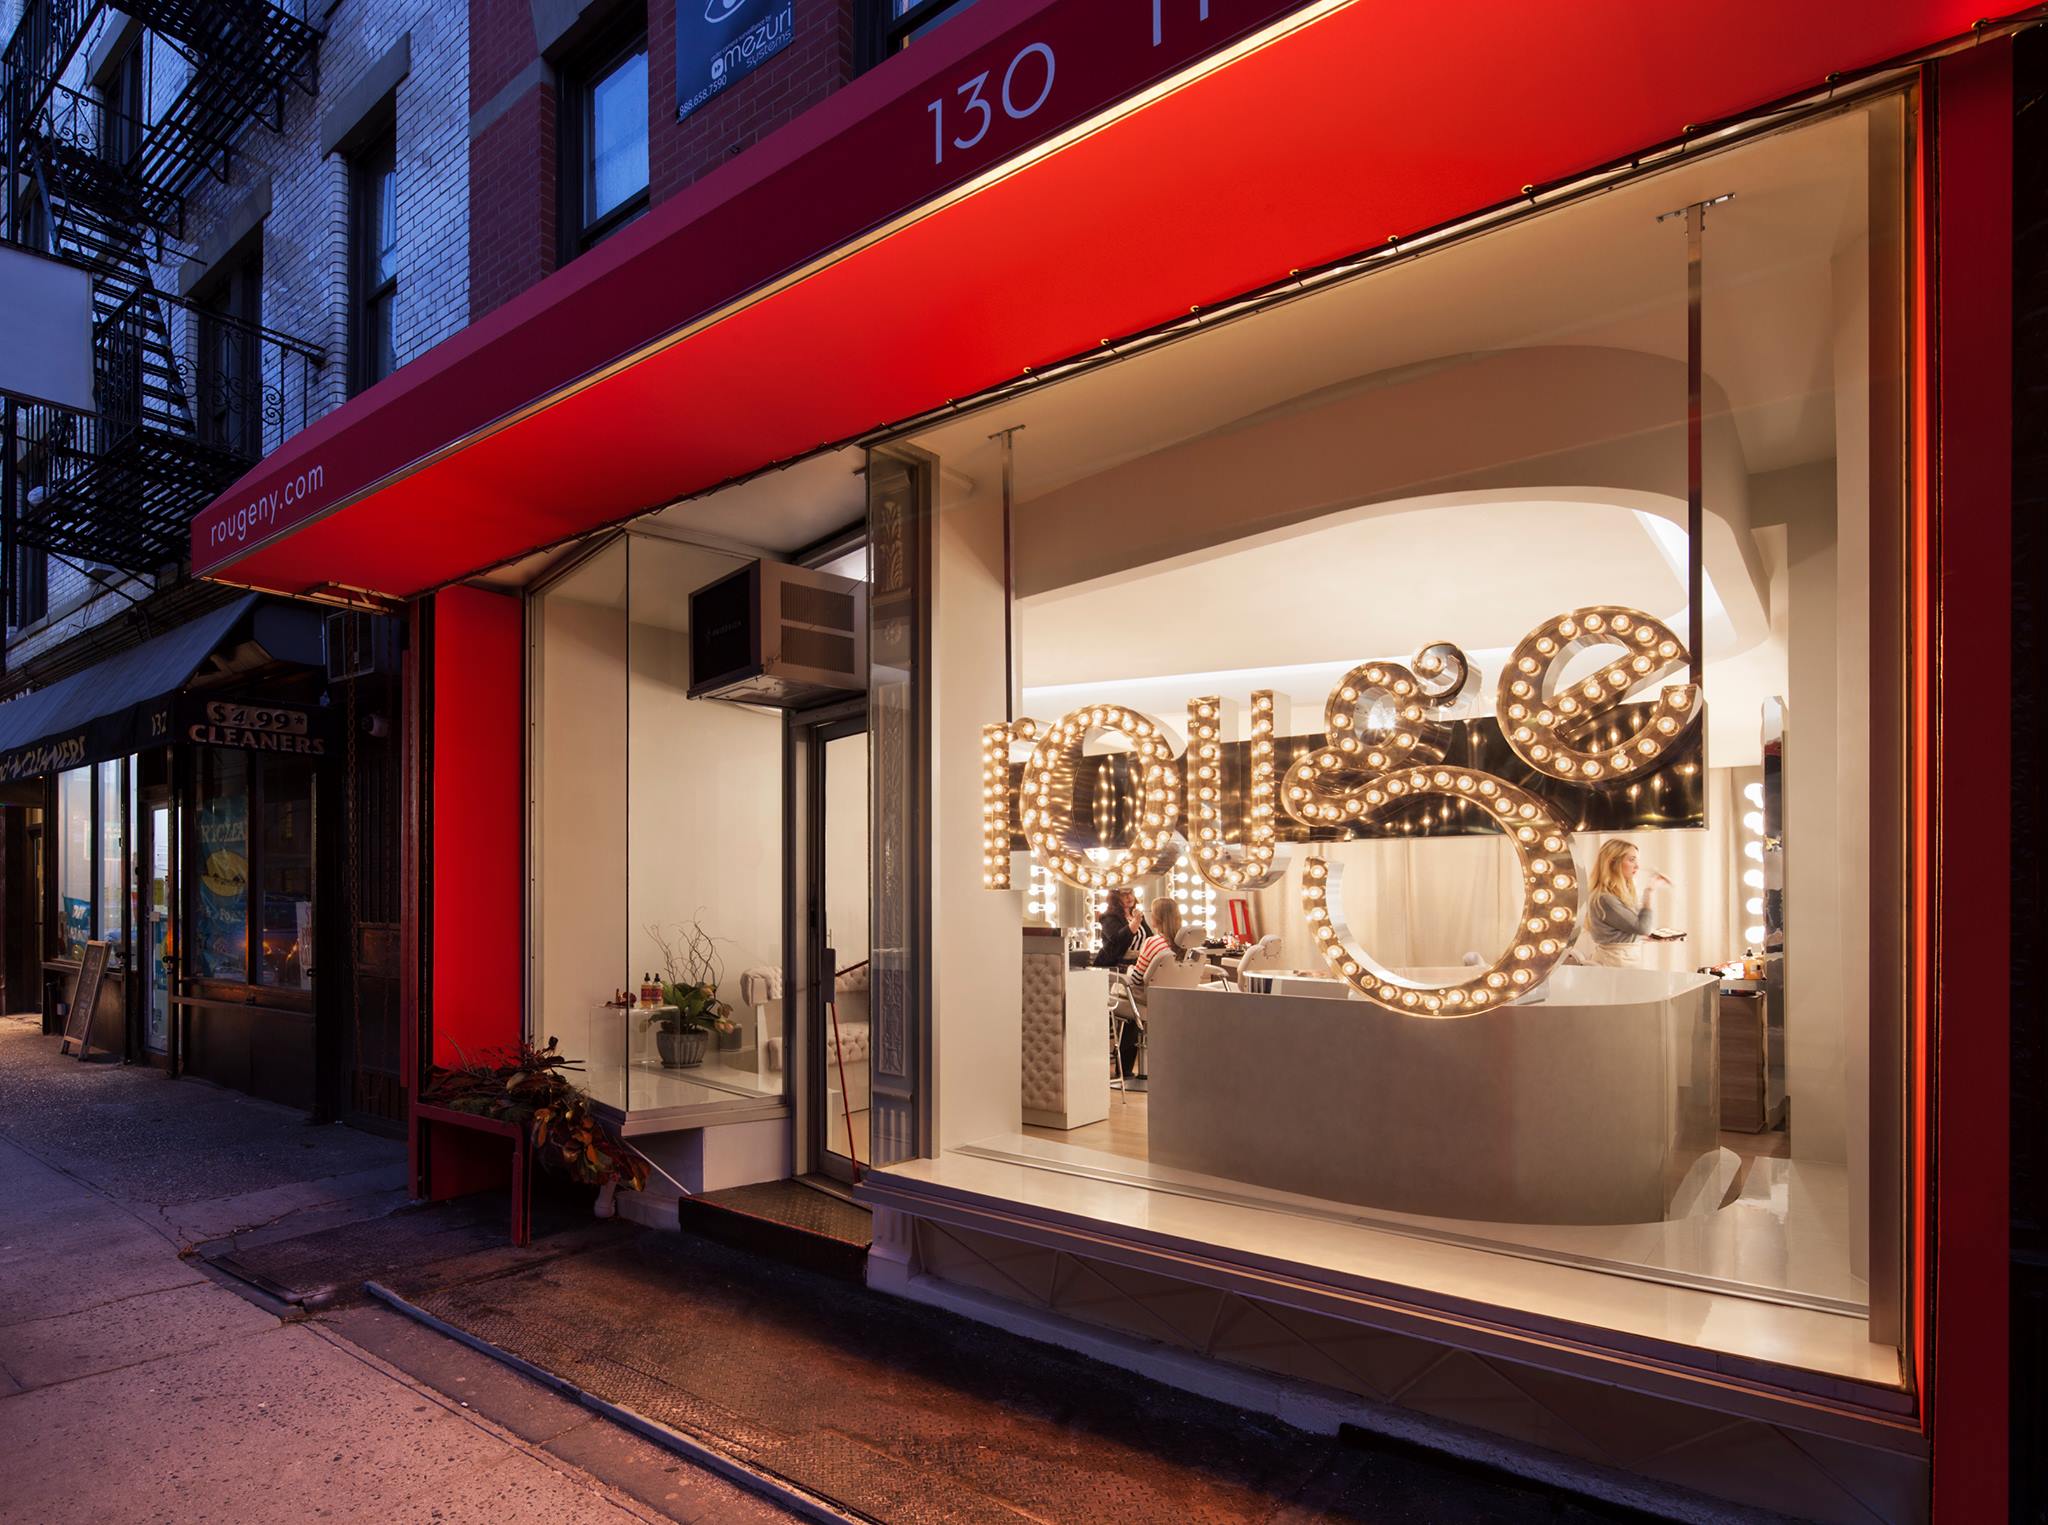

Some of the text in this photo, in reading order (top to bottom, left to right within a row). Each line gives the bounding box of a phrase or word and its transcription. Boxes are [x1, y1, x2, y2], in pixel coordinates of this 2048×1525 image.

[725, 1, 792, 73] mezuri
[746, 31, 792, 68] systems
[927, 42, 1055, 165] 130
[210, 464, 323, 547] rougeny.com
[188, 724, 326, 755] CLEANERS
[983, 605, 1703, 1019] rouge
